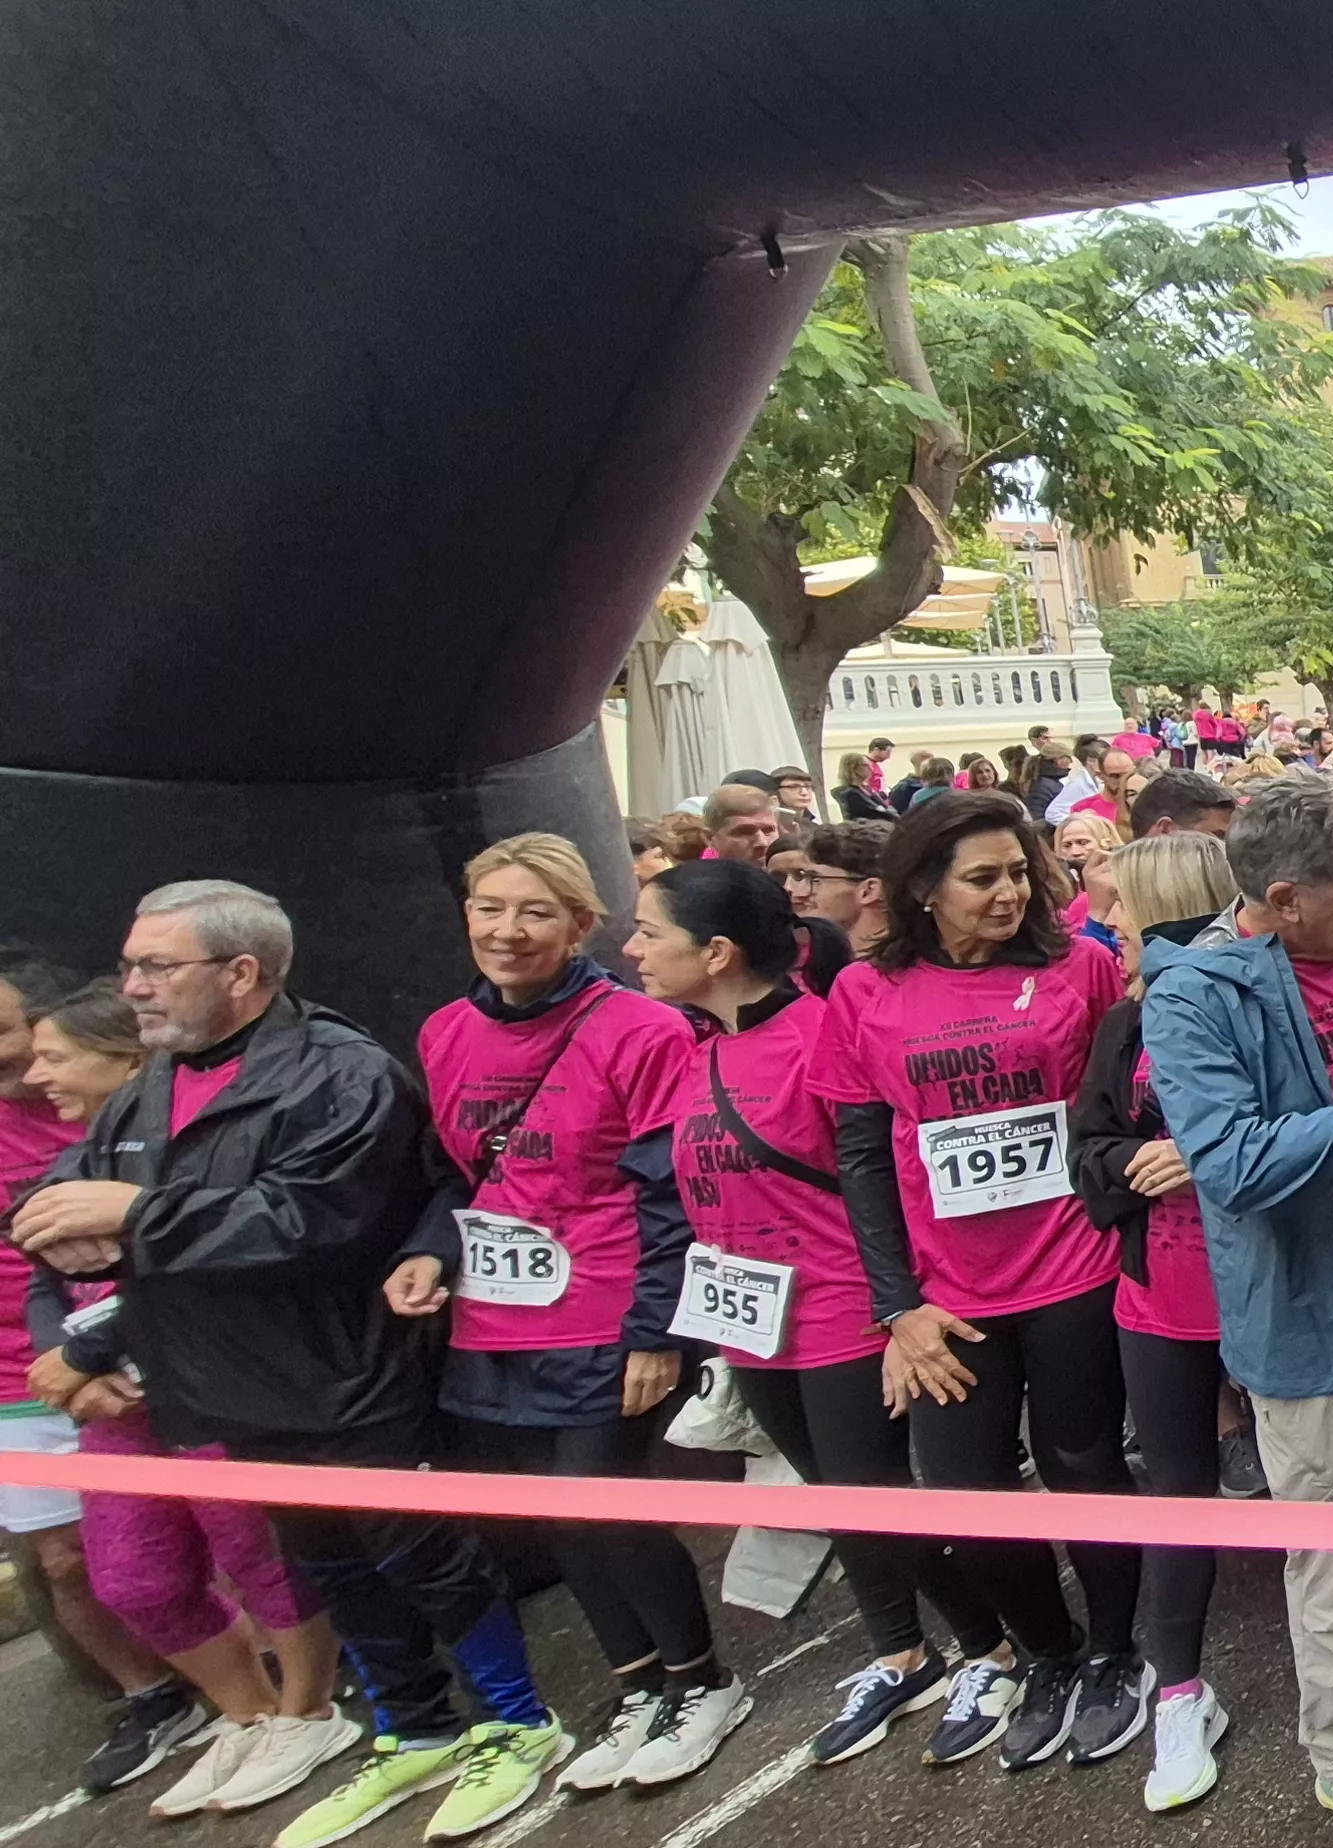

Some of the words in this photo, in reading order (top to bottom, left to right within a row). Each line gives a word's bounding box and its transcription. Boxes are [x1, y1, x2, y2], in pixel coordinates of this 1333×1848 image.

[953, 1015, 998, 1030] CARRERA
[983, 1025, 996, 1034] EL
[905, 1042, 997, 1087] UNIDOS
[947, 1077, 981, 1111] EN
[983, 1067, 1045, 1105] CADA
[936, 1134, 987, 1150] CONTRA
[988, 1132, 1003, 1142] EL
[1004, 1121, 1051, 1140] CÁNCER
[974, 1122, 1012, 1135] HUESCA
[938, 1136, 1055, 1189] 1957
[470, 1242, 554, 1279] 1518
[704, 1283, 759, 1326] 955
